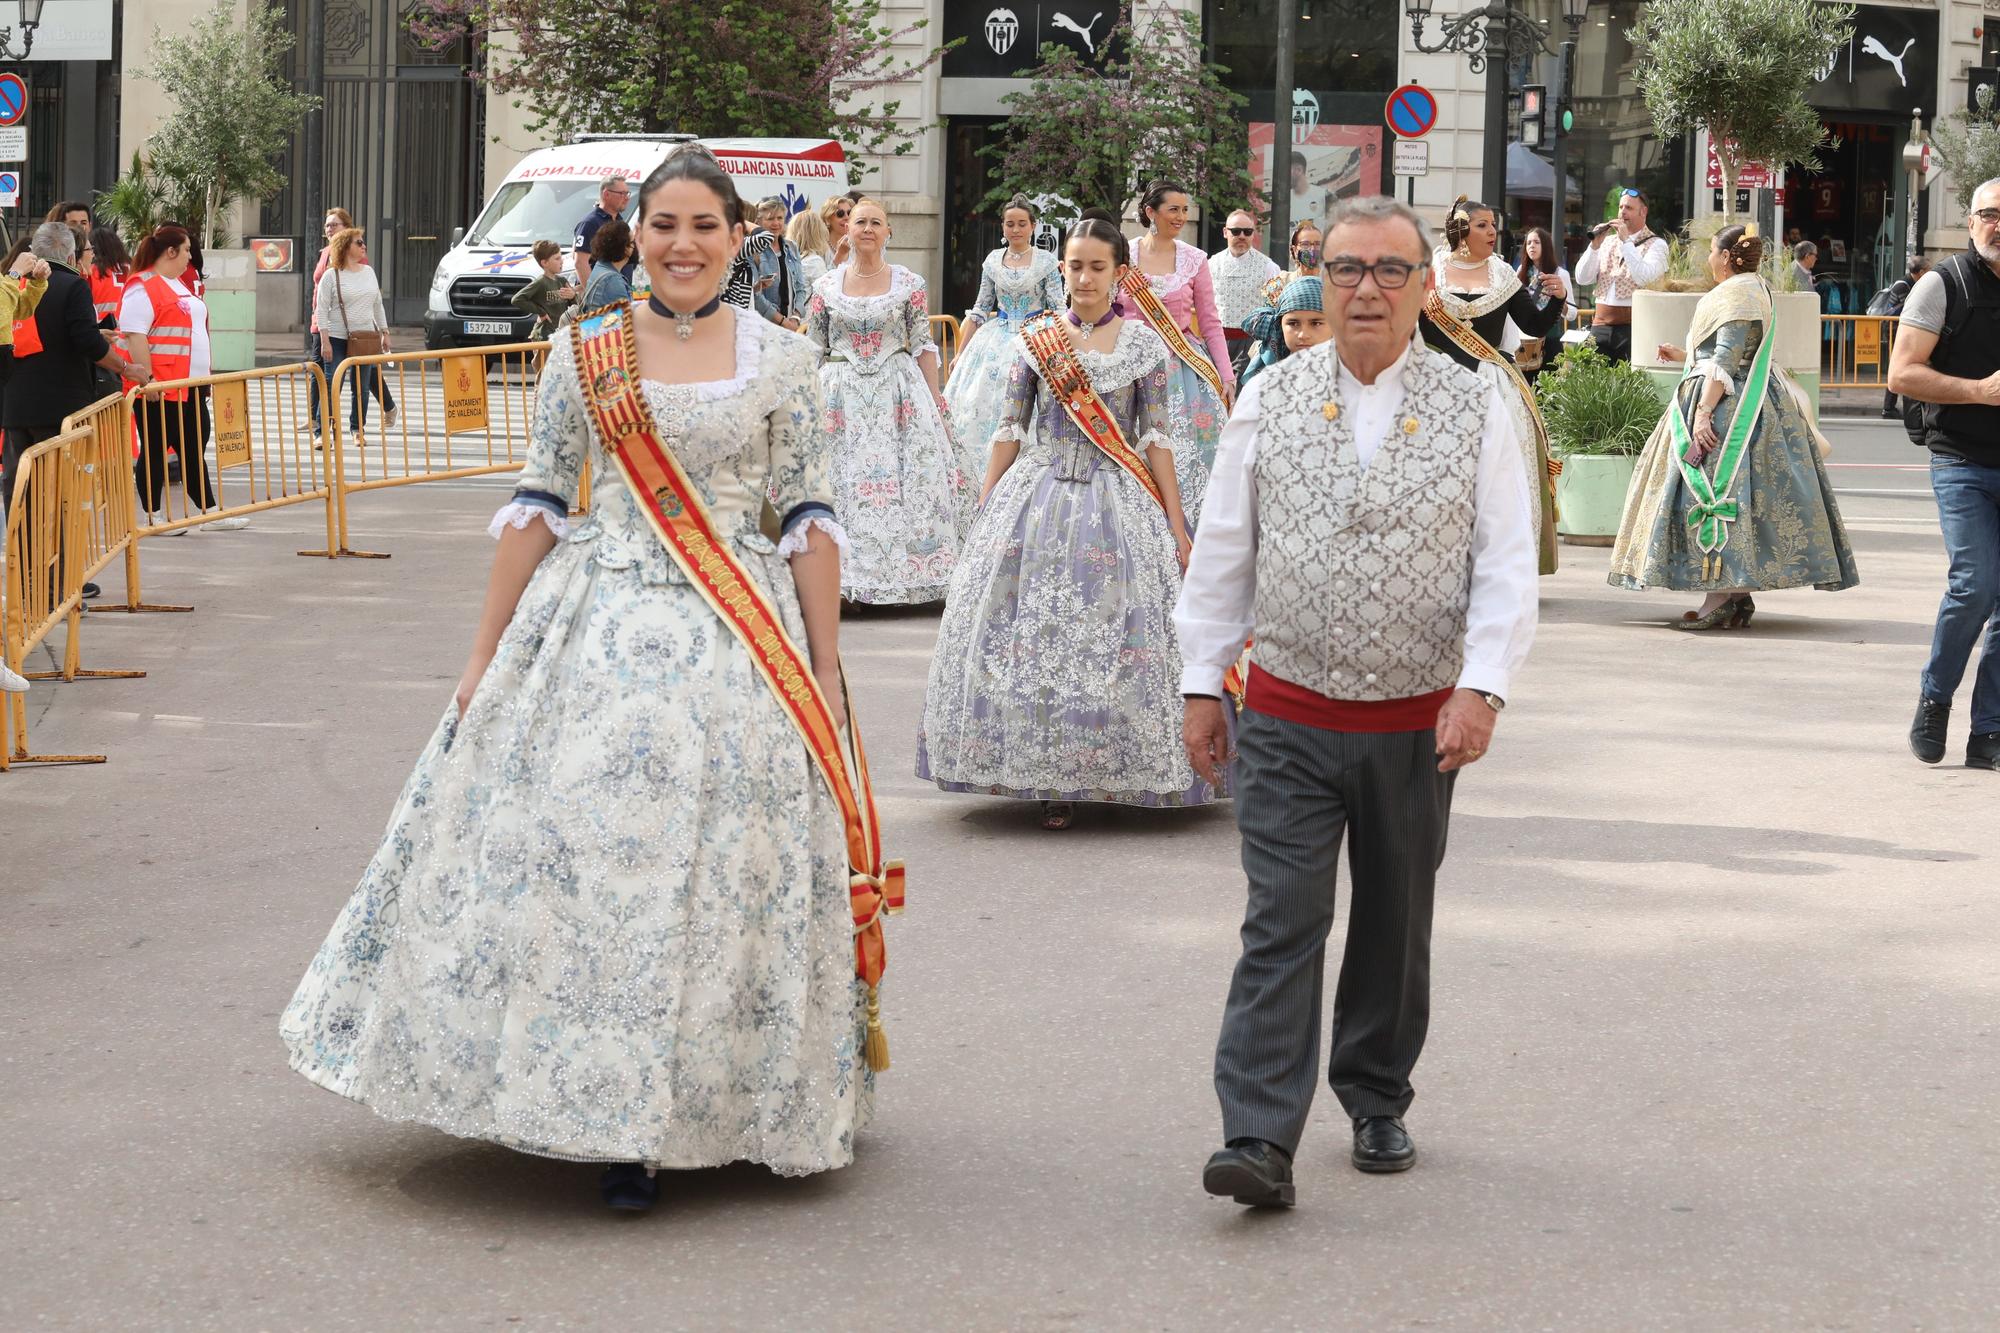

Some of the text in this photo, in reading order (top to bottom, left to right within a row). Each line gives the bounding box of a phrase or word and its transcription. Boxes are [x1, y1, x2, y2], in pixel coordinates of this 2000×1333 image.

[719, 160, 835, 178] BULANCIAS VALLADA
[1740, 193, 1749, 201] CF
[1822, 188, 1831, 207] 9
[469, 322, 511, 334] 5372 LRV
[448, 397, 482, 409] AJUNTAMENT
[448, 410, 456, 419] DE
